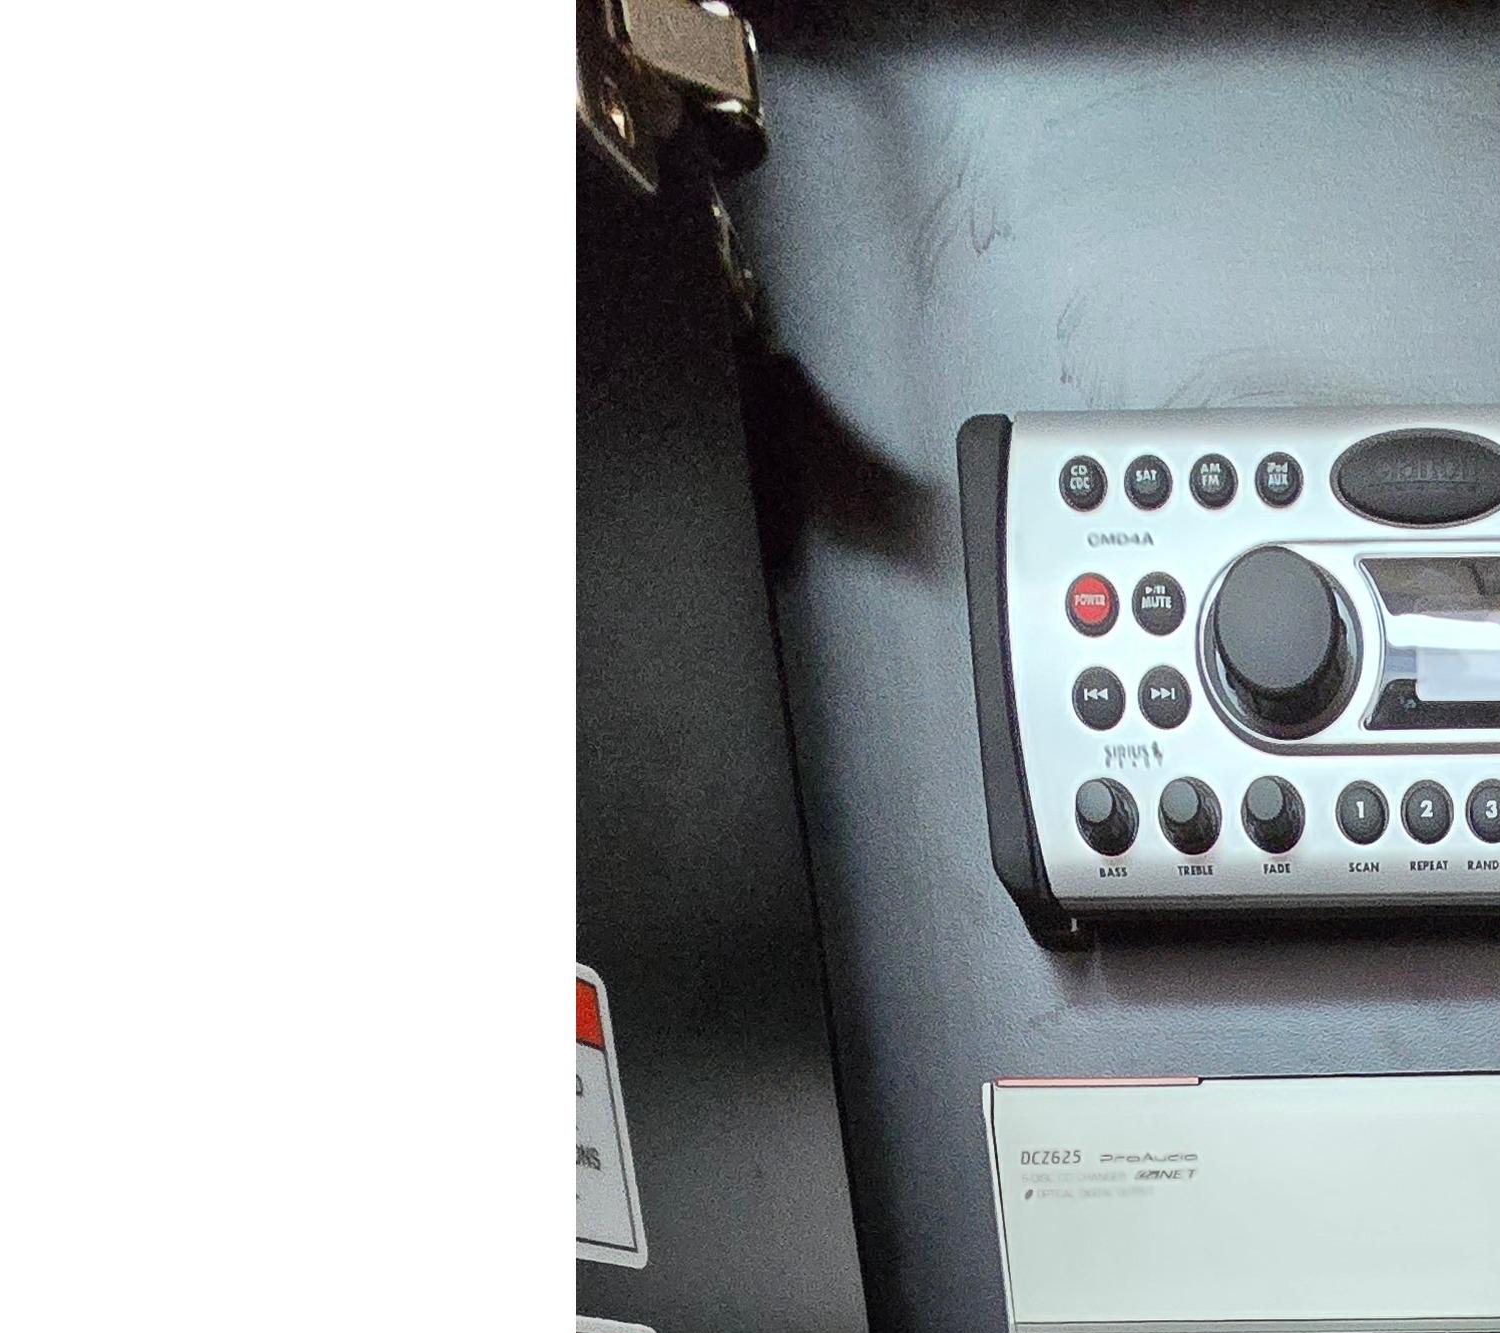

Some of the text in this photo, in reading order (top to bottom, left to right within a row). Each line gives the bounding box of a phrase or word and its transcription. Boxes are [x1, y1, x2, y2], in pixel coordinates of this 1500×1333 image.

[1070, 465, 1086, 476] CD
[1200, 463, 1220, 474] AM
[1266, 462, 1288, 473] iPod
[1136, 471, 1157, 482] SAT
[1202, 475, 1219, 486] FM
[1268, 475, 1288, 485] AUX
[1070, 478, 1090, 489] CDC
[1075, 595, 1105, 606] POWER
[1141, 596, 1171, 609] MUTE
[1356, 801, 1364, 818] 1
[1420, 801, 1433, 817] 2
[1485, 801, 1497, 818] 3
[1177, 865, 1213, 876] TREBLE
[1264, 864, 1291, 874] FADE
[1348, 862, 1379, 873] SCAN
[1410, 860, 1448, 871] REPEAT
[1100, 867, 1128, 877] BASS
[1021, 1150, 1081, 1166] DCZ625
